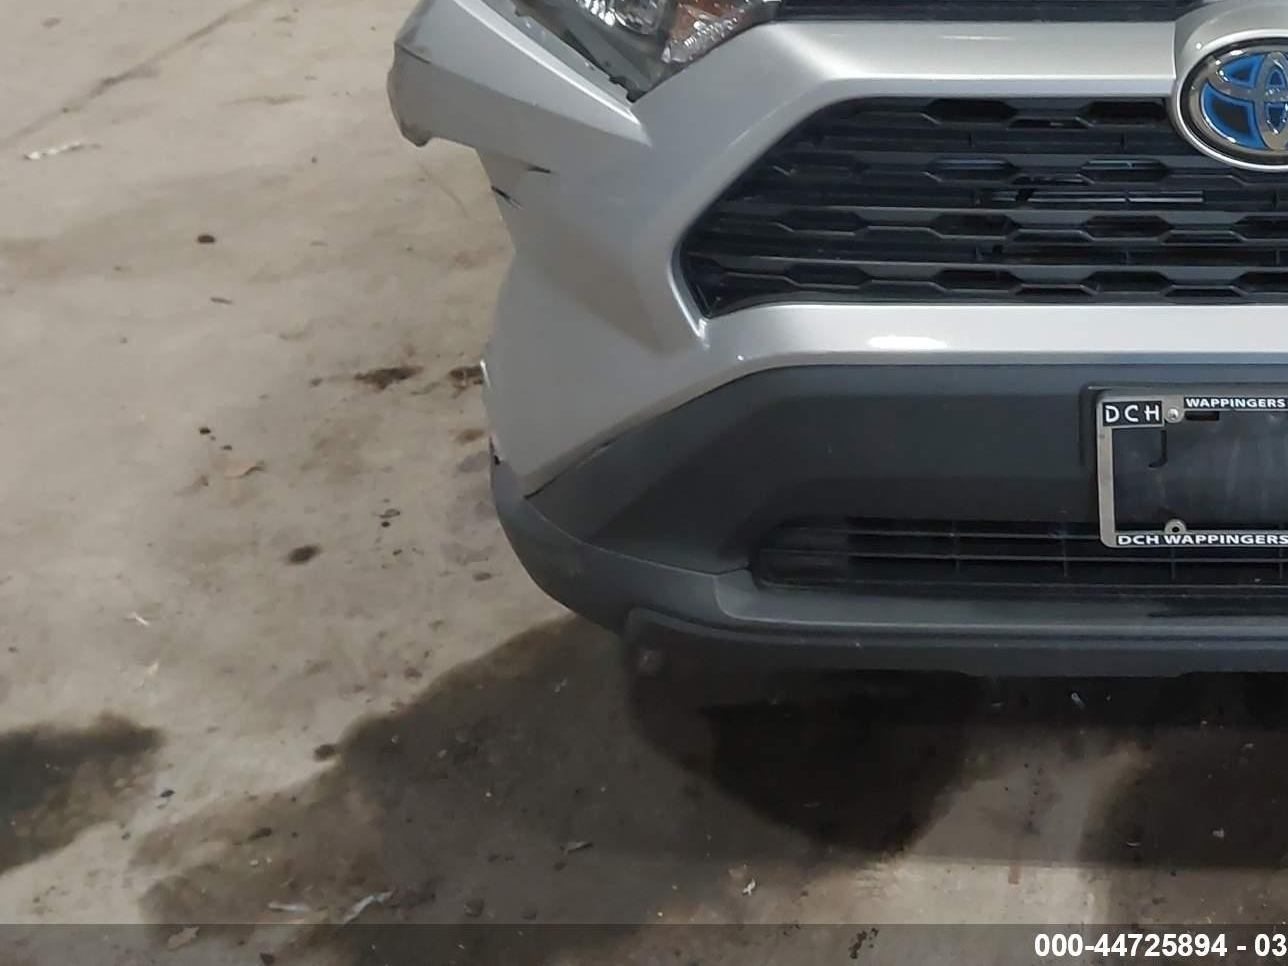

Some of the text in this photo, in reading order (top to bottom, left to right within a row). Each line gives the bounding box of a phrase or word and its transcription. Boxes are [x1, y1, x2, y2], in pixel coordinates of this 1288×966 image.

[1186, 397, 1285, 409] WAPPINGERS
[1105, 404, 1161, 423] DCH
[1118, 535, 1160, 546] DCH
